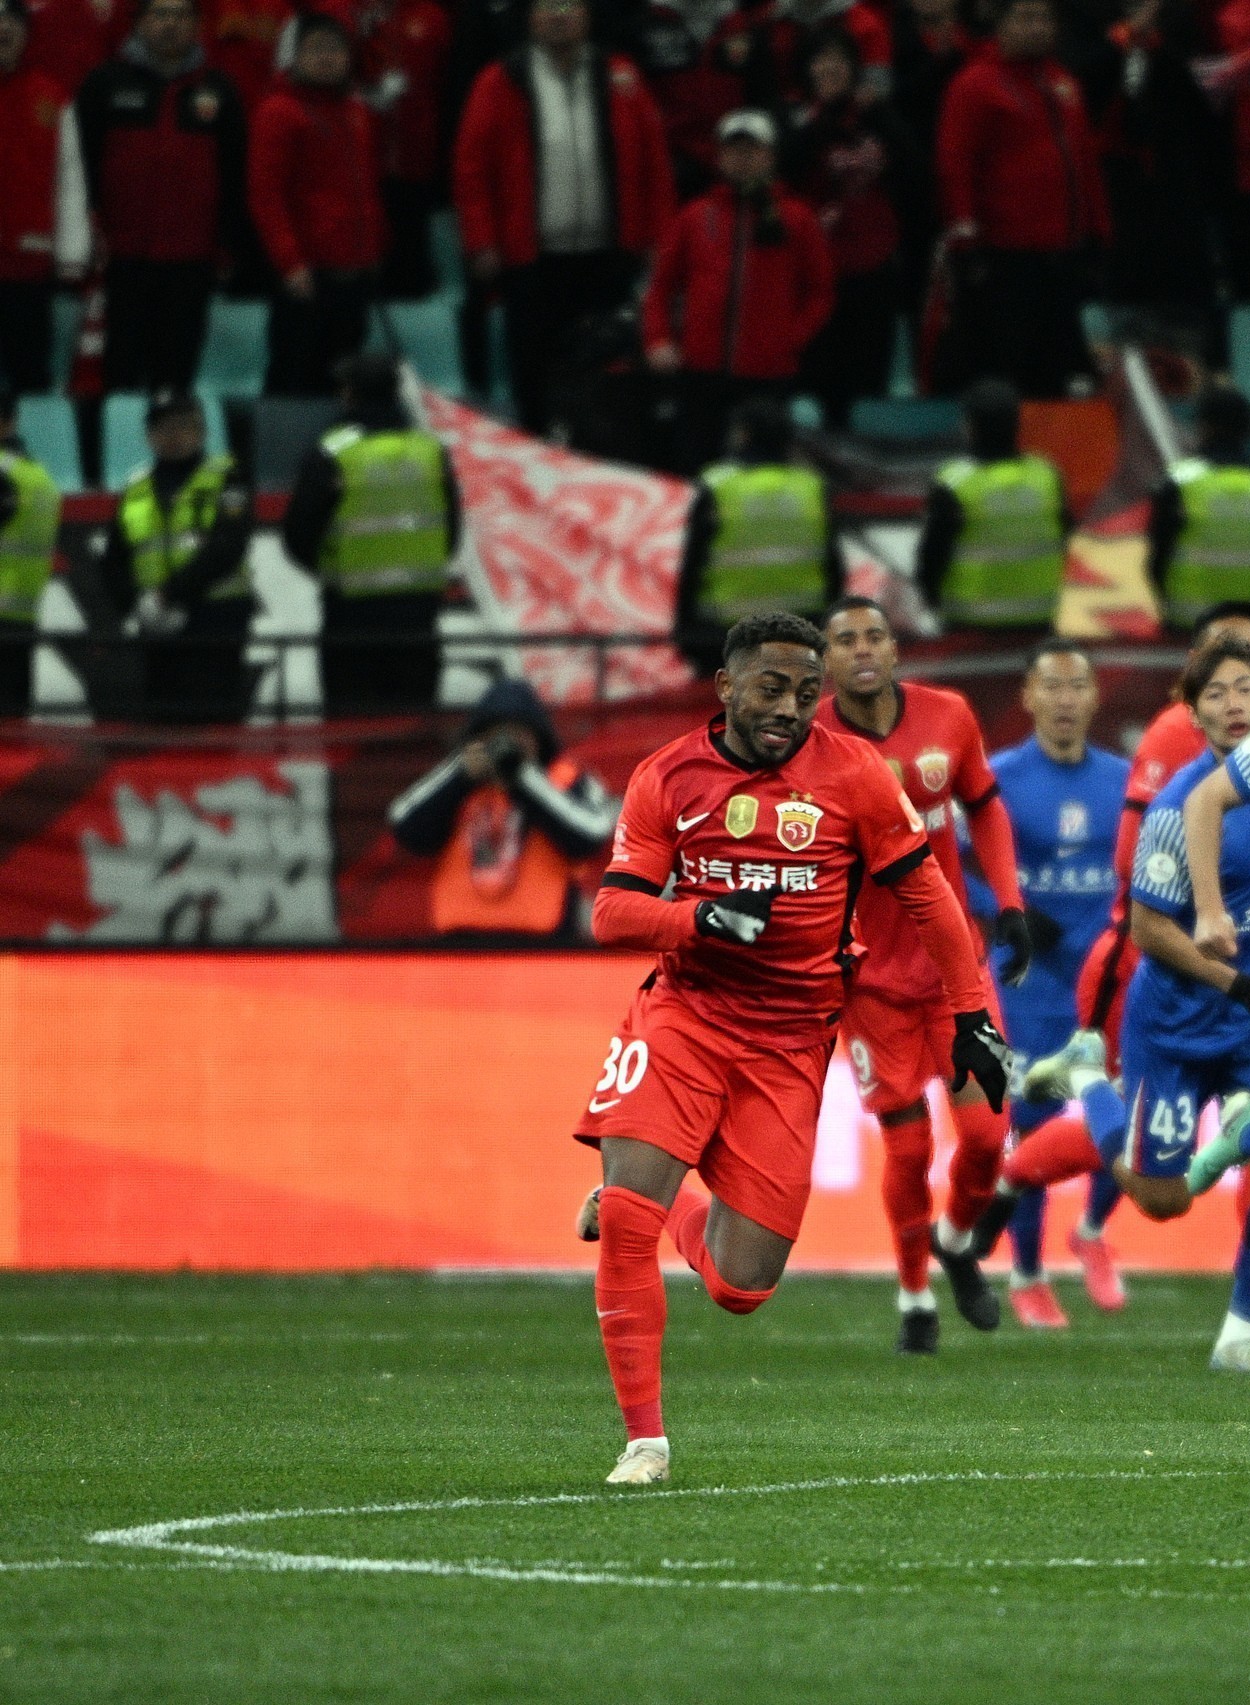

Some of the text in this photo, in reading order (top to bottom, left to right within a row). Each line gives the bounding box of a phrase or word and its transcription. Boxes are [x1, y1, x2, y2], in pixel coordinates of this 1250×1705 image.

[680, 850, 819, 893] 上汽荣威
[595, 1036, 648, 1095] 30
[850, 1040, 871, 1082] 9
[1149, 1095, 1194, 1145] 43
